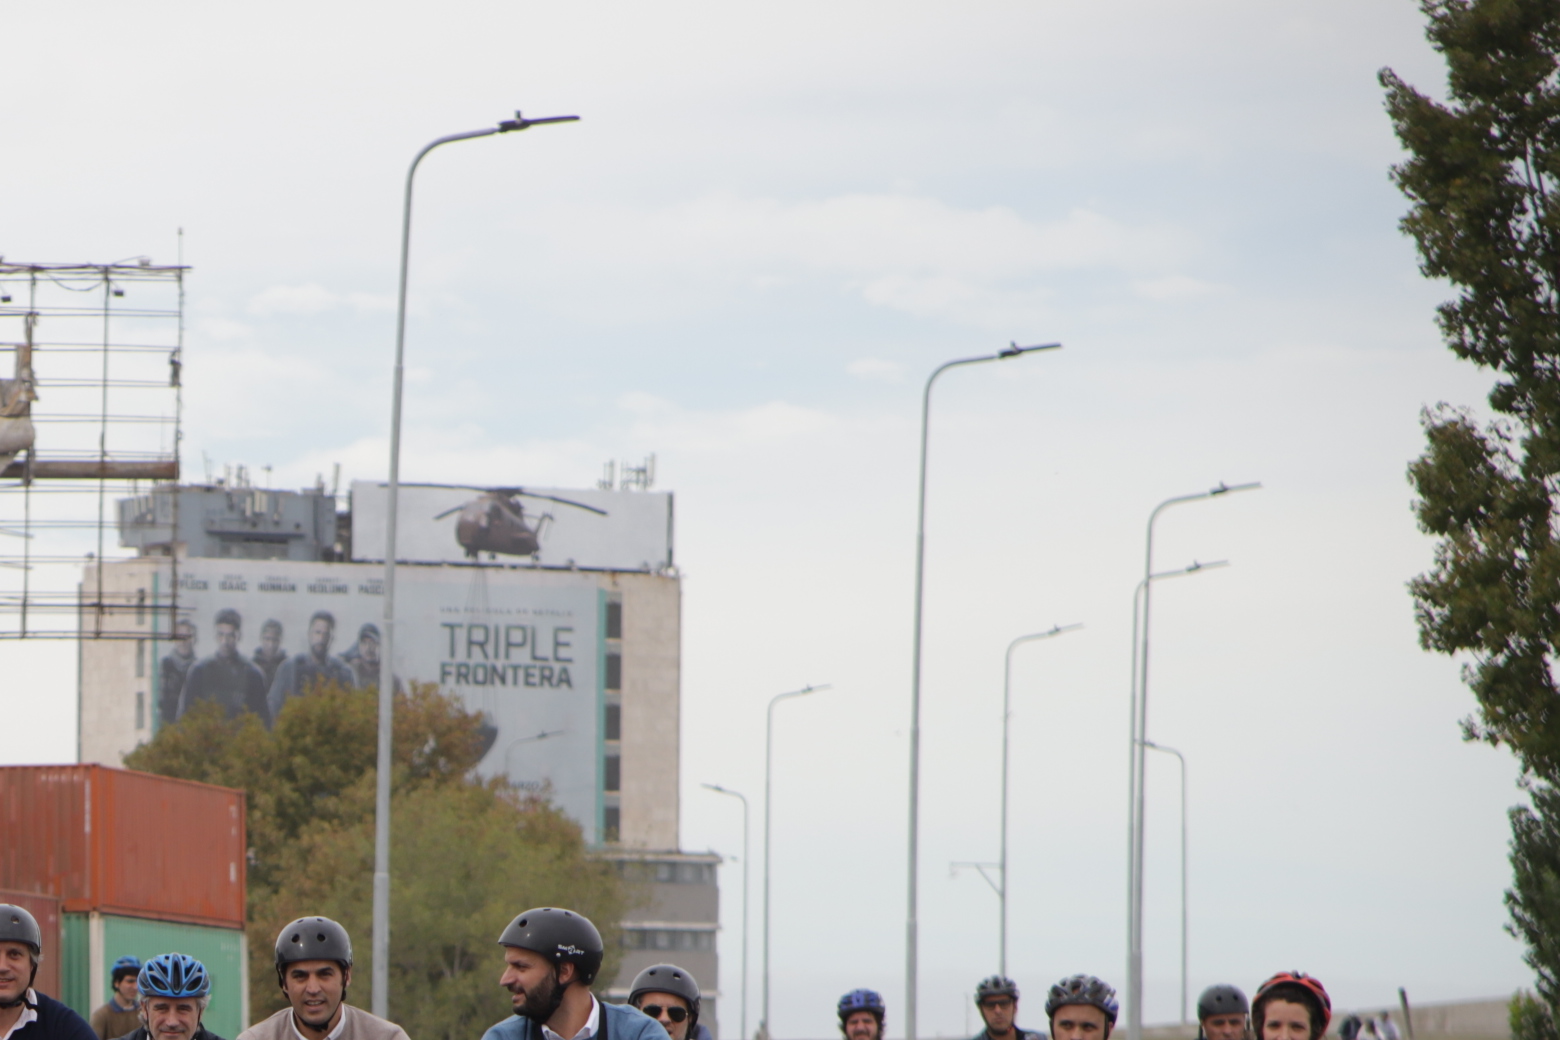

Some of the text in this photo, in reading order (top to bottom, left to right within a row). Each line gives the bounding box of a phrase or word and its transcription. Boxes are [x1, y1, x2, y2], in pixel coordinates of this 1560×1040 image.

[358, 584, 384, 596] PASC
[440, 622, 574, 663] TRIPLE
[440, 661, 573, 689] FRONTERA
